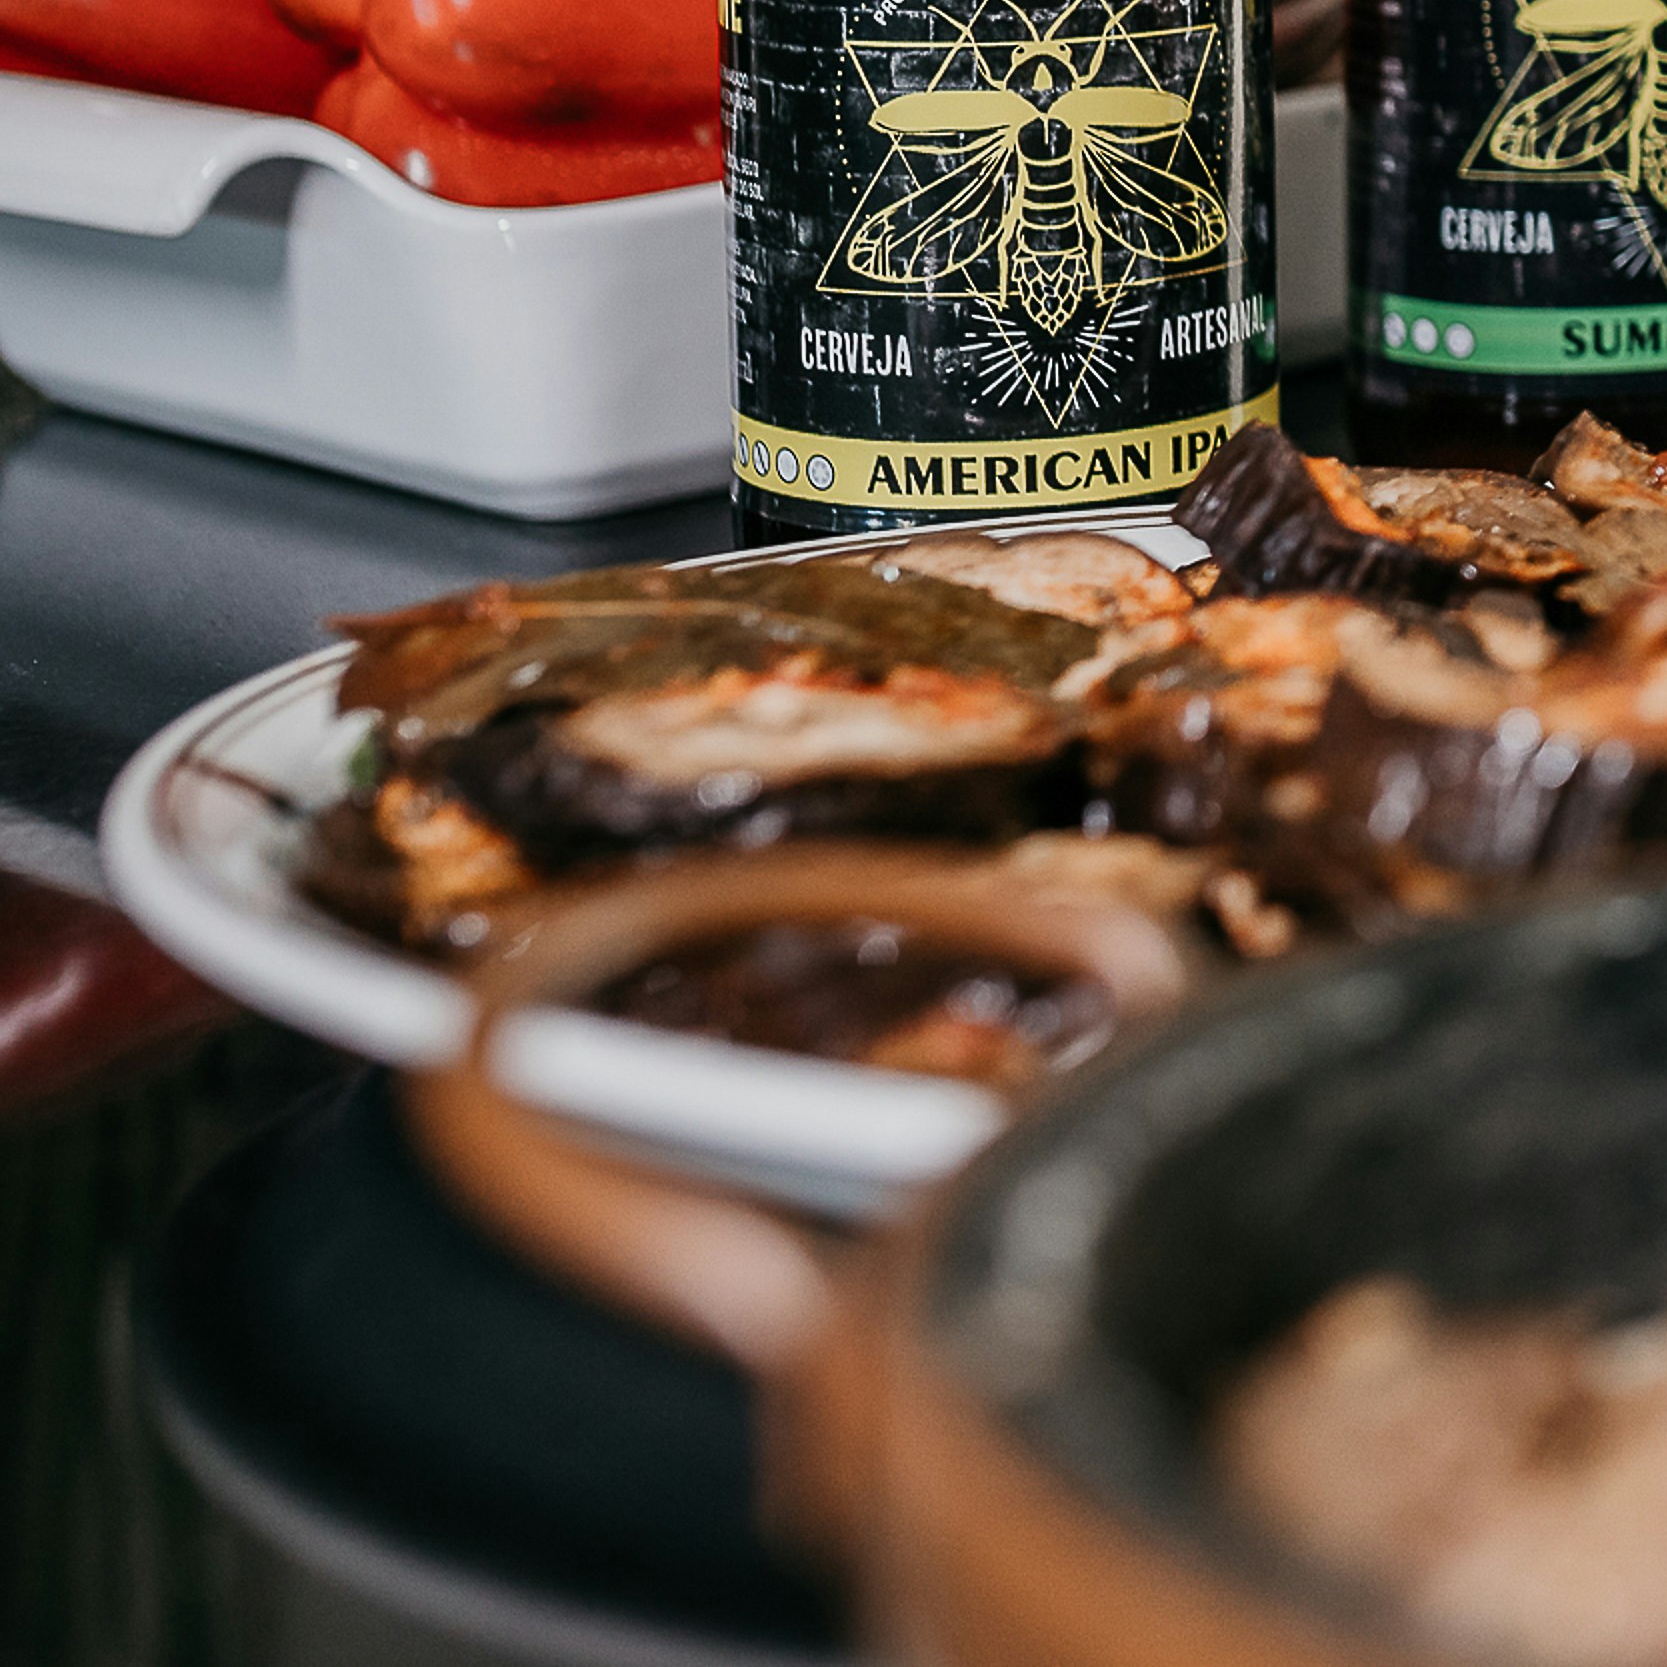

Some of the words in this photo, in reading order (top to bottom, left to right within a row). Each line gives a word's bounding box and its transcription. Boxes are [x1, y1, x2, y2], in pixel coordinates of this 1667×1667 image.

[1440, 205, 1555, 254] CERVEJA
[800, 326, 914, 377] CERVEJA
[1160, 293, 1267, 361] ARTESANAL
[867, 441, 1153, 496] AMERICAN
